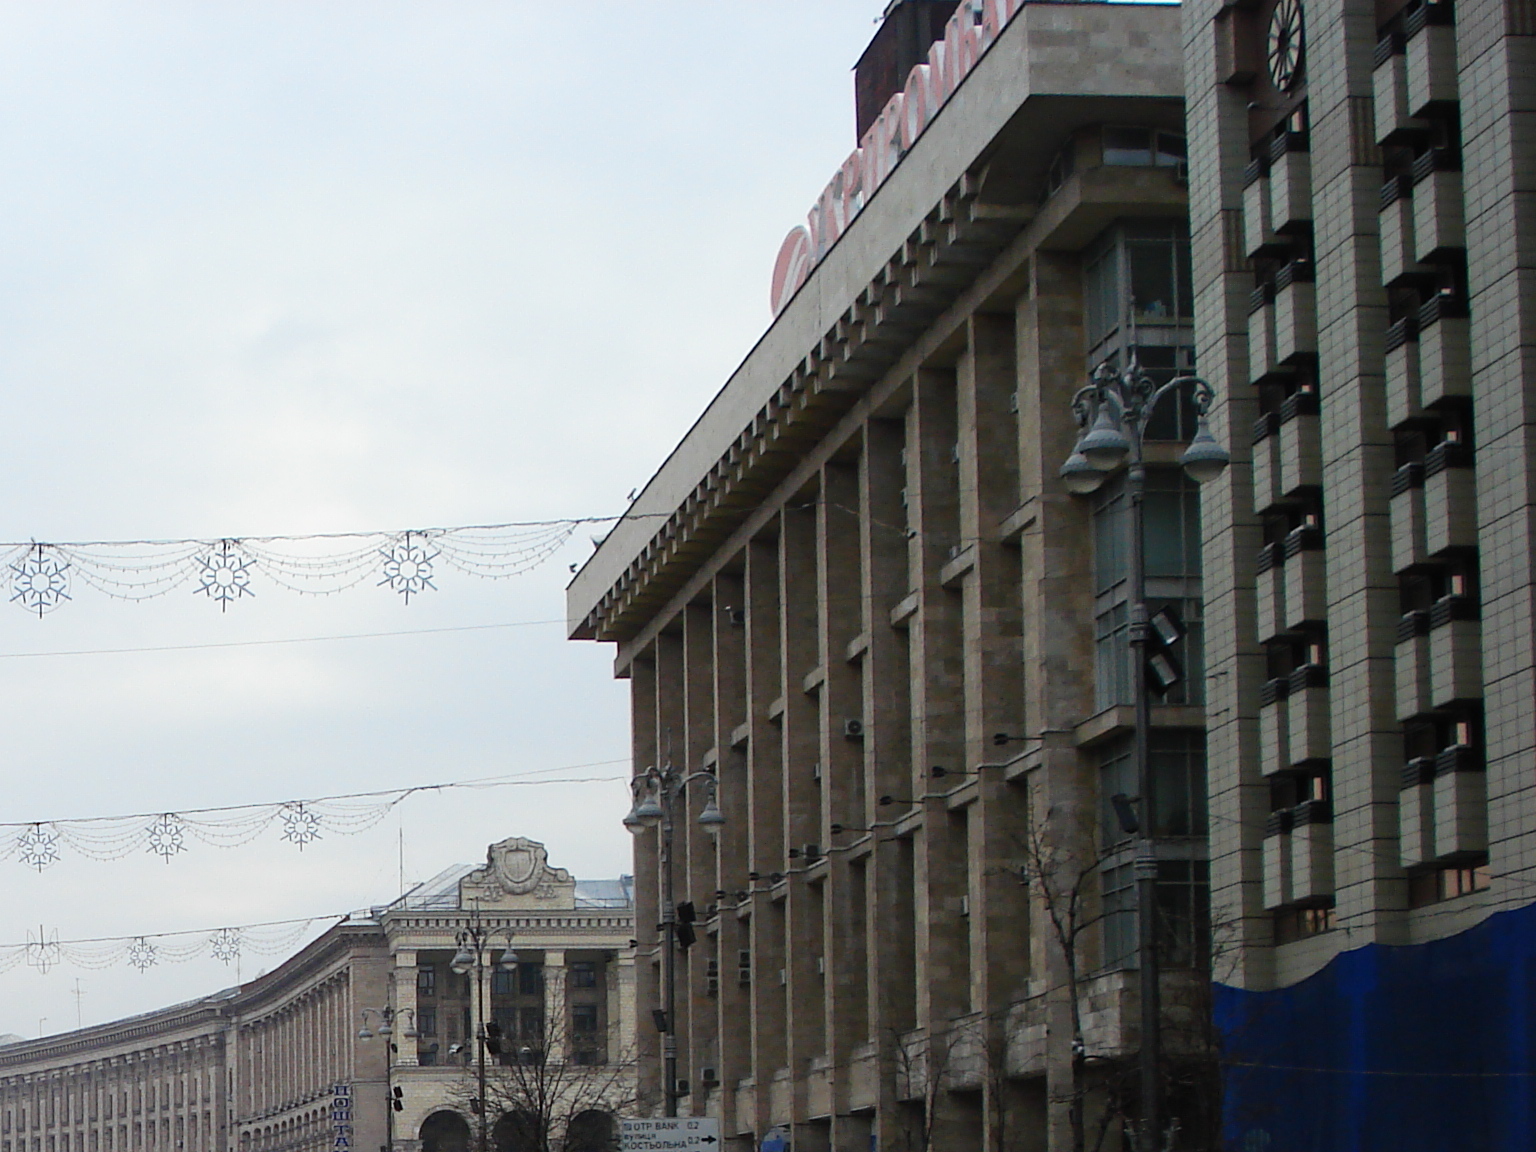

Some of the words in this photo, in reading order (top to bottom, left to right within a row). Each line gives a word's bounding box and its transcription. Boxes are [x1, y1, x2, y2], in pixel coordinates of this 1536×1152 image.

[633, 1122, 652, 1131] OTP
[655, 1122, 679, 1130] BANK
[624, 1141, 687, 1150] КОСТЬОЛЬНА
